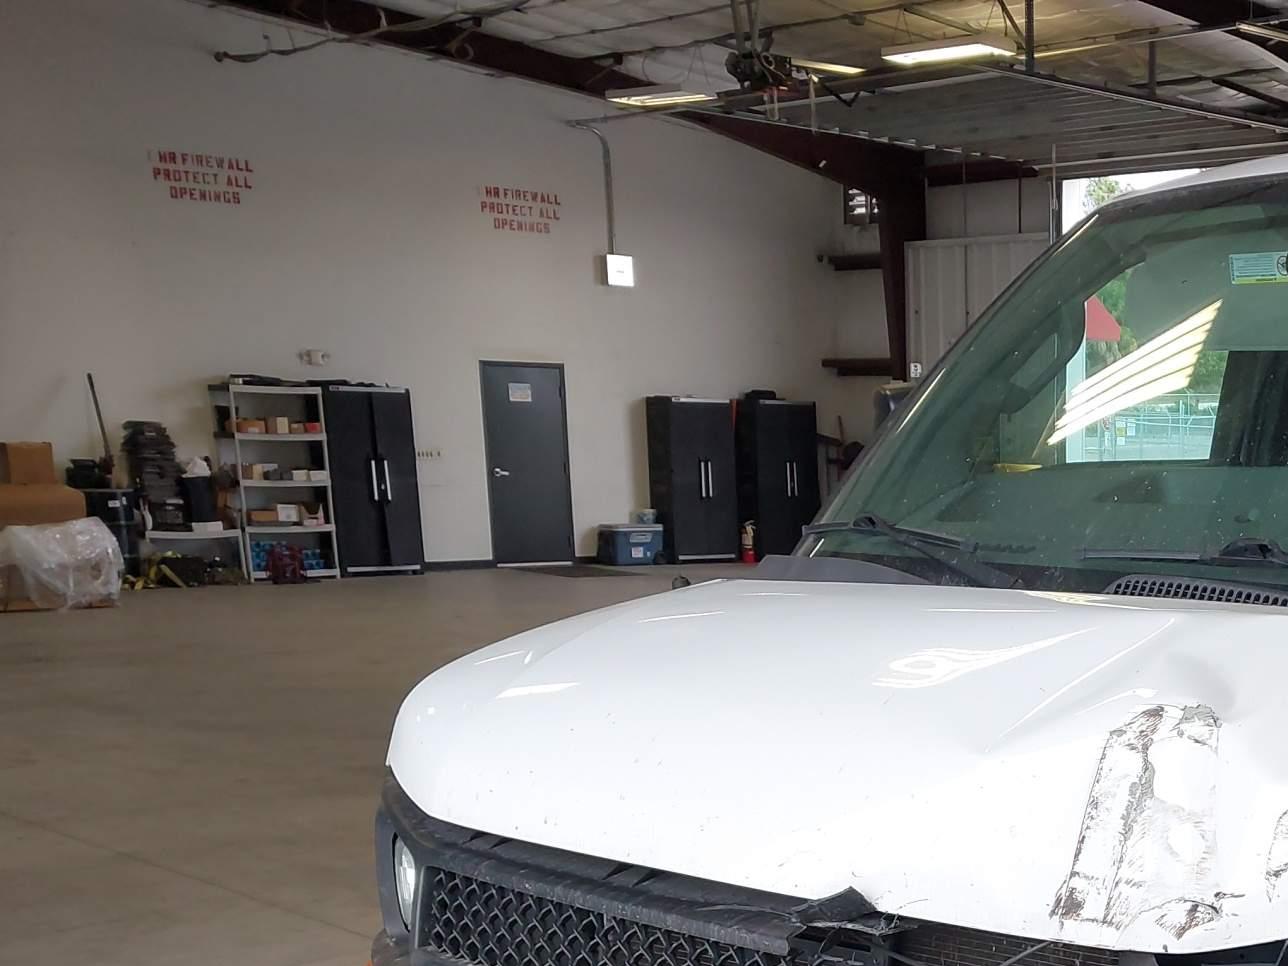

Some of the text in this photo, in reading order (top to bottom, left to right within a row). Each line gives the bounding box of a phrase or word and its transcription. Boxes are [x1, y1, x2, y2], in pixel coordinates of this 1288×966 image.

[158, 150, 177, 165] HR
[181, 153, 254, 173] FIREWALL
[152, 167, 252, 190] PROTECT ALL
[169, 186, 241, 205] OPENINGS
[485, 186, 500, 199] HR
[503, 188, 561, 206] FIREWALL
[480, 201, 561, 221] PROTECT ALL
[493, 217, 551, 234] OPENINGS
